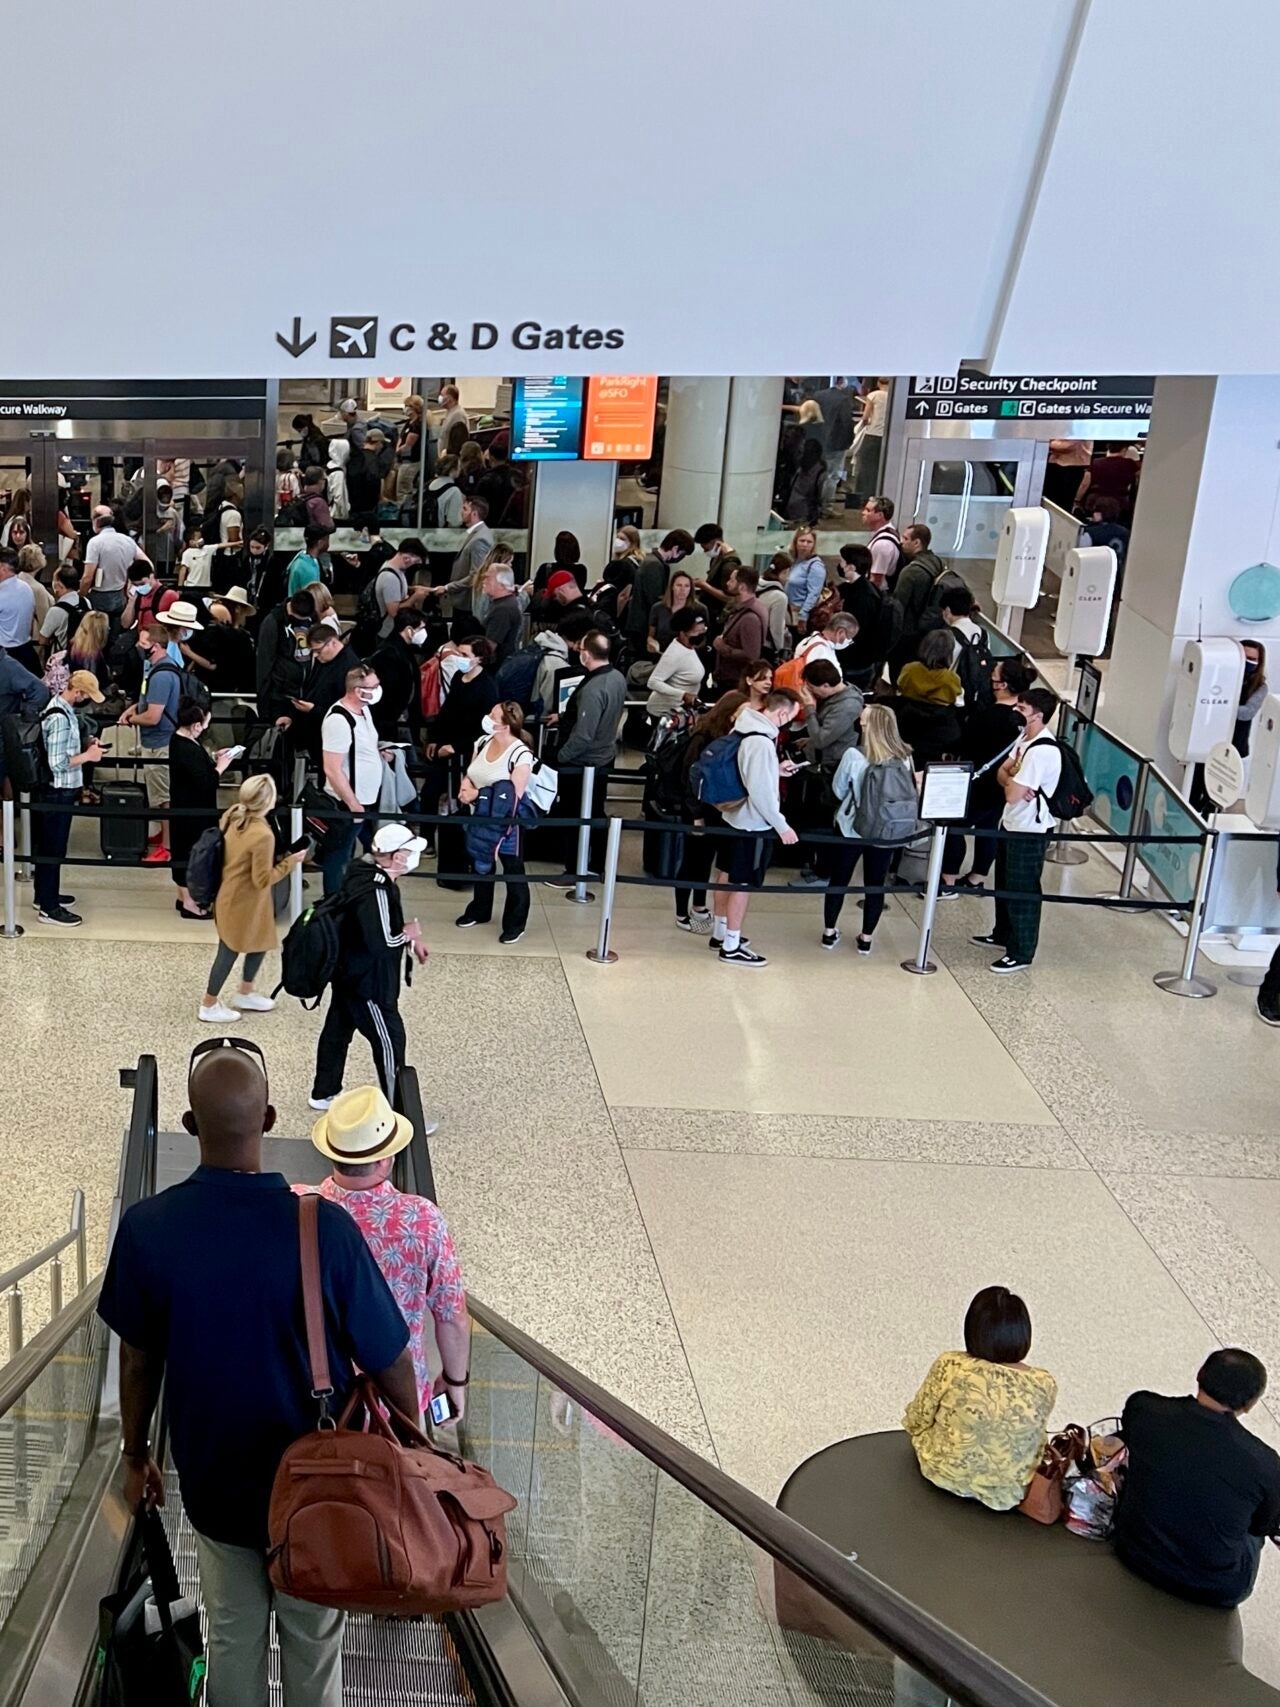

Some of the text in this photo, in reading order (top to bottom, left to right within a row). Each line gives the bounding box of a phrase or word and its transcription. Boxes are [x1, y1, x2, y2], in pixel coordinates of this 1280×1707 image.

[389, 321, 625, 351] C & D Gates
[960, 377, 1018, 393] Security
[1020, 378, 1098, 393] Checkpoint
[598, 388, 628, 399] @SFO
[23, 404, 67, 417] Walkway
[954, 402, 989, 414] Gates
[1037, 403, 1072, 414] Gates
[1074, 404, 1091, 414] via
[1092, 403, 1133, 414] Secure
